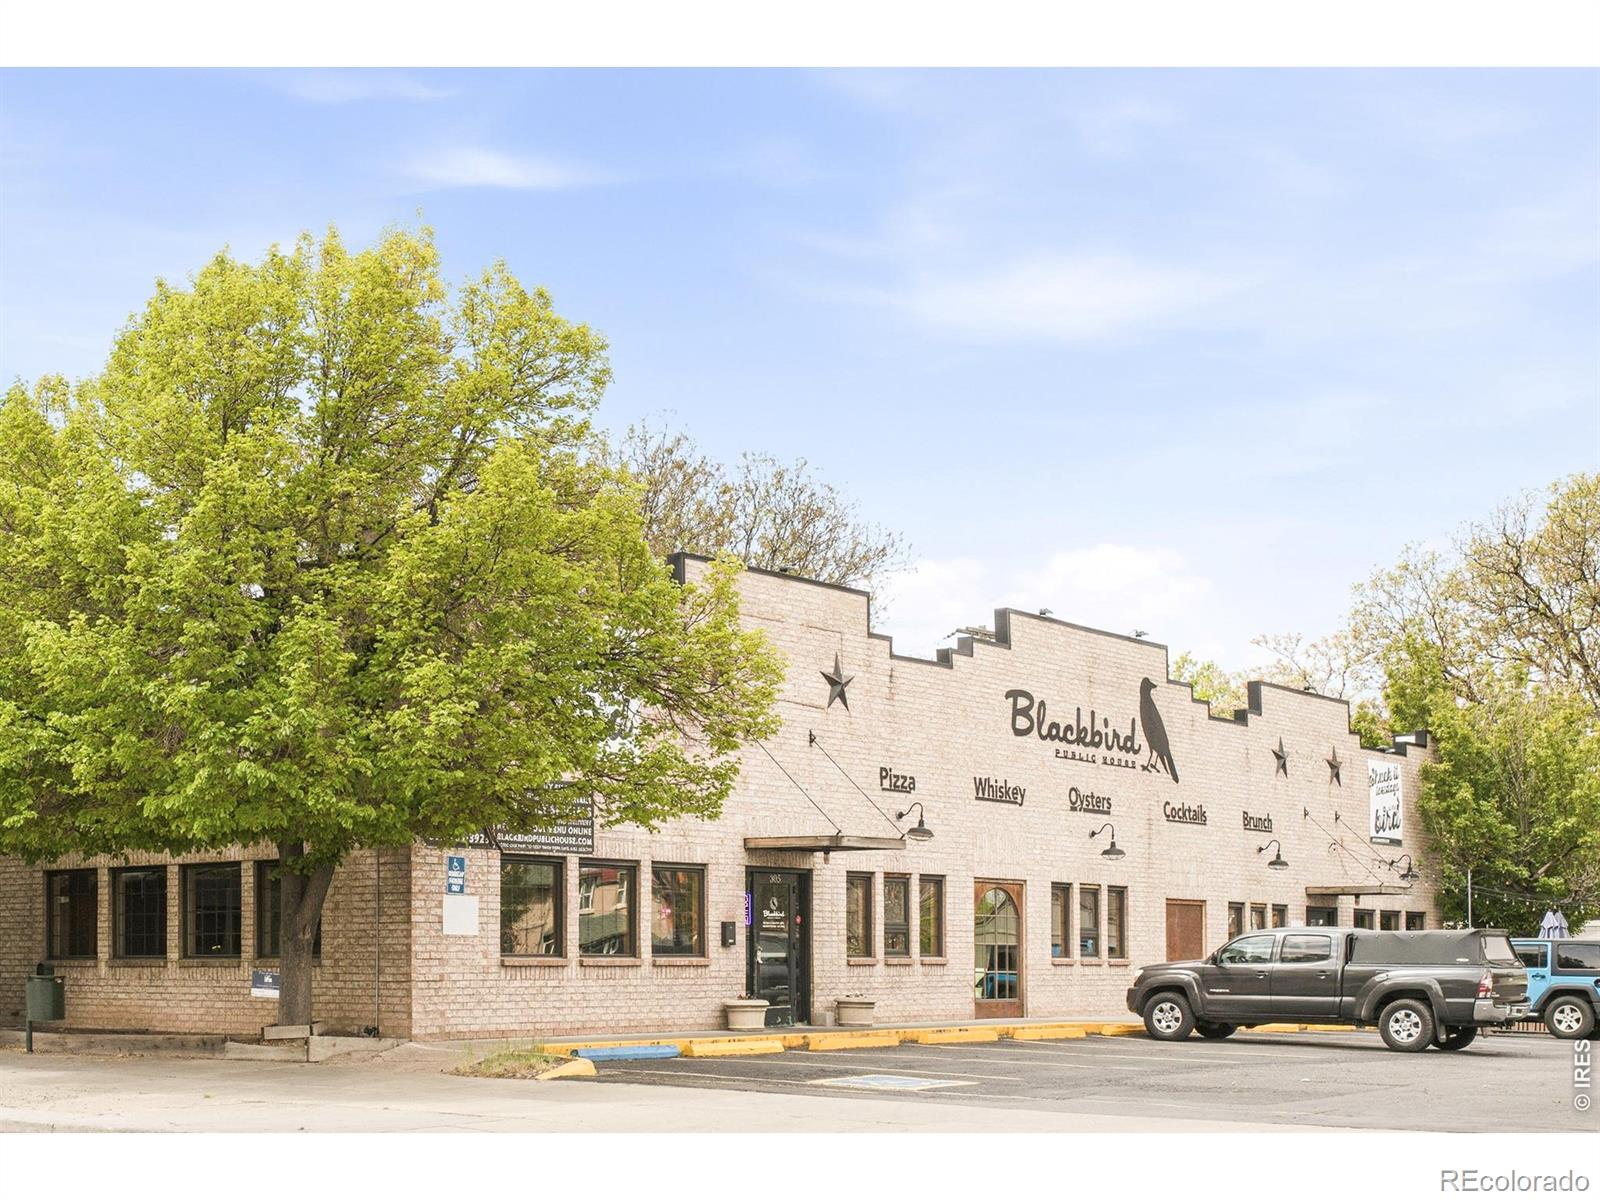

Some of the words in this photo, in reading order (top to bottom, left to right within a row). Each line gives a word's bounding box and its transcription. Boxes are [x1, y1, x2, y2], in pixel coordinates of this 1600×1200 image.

[1004, 689, 1142, 755] Blackbird
[1055, 748, 1097, 763] PUBLIC
[1102, 755, 1137, 769] HOUSE
[879, 766, 916, 792] Pizza
[973, 776, 1026, 807] Whiskey
[1068, 787, 1112, 812] Oysters
[1163, 800, 1208, 824] Cocktails
[1242, 811, 1273, 831] Brunch
[567, 826, 592, 836] ONLINE
